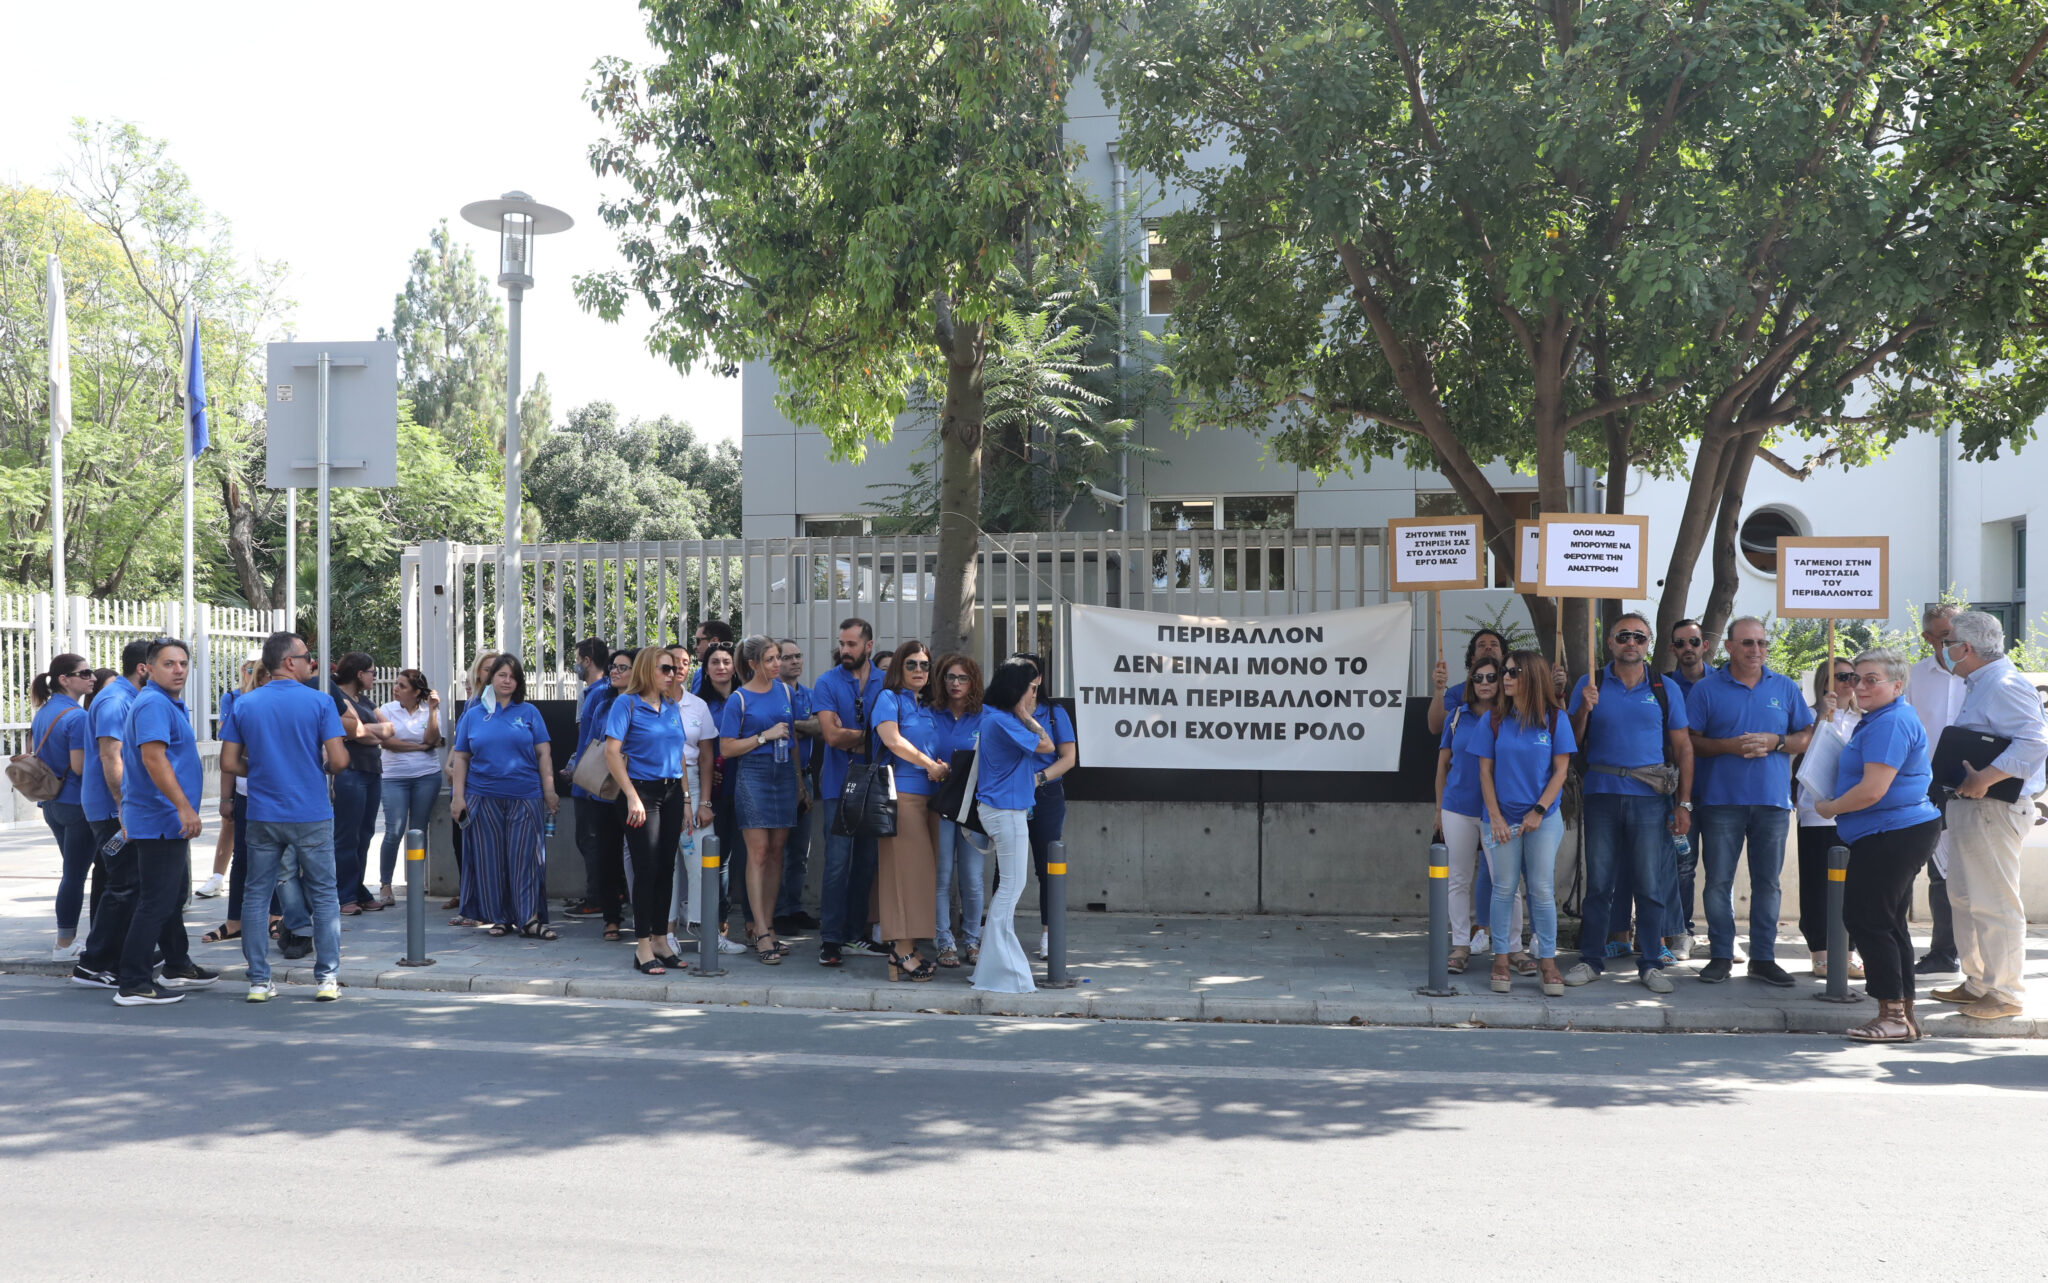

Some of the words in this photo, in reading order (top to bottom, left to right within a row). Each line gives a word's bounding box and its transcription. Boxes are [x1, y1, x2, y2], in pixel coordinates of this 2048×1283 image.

[1404, 530, 1447, 538] ΖΗΤΟΥΜΕ
[1447, 529, 1467, 537] ΤΗΝ
[1572, 529, 1594, 537] ΟΛΟΙ
[1594, 529, 1615, 537] ΜΑΖΙ
[1414, 539, 1452, 547] ΣΤΗΡΙΞΗ
[1453, 538, 1471, 546] ΣΑΣ
[1570, 541, 1618, 549] ΜΠΟΡΟΥΜΕ
[1619, 542, 1632, 550] ΝΑ
[1405, 549, 1424, 557] ΣΤΟ
[1424, 548, 1467, 556] ΔΥΣΚΟΛΟ
[1563, 552, 1605, 560] ΦΕΡΟΥΜΕ
[1605, 553, 1623, 561] ΤΗΝ
[1415, 558, 1438, 566] ΕΡΓΟ
[1439, 557, 1458, 565] ΜΑΣ
[1793, 559, 1843, 567] ΤΑΓΜΕΝΟΙ
[1845, 559, 1872, 567] ΣΤΗΝ
[1567, 564, 1619, 572] ΑΝΑΣΤΡΟΦΗ
[1805, 569, 1860, 577] ΠΡΟΣΤΑΣΙΑ
[1822, 579, 1842, 587] ΤΟΥ
[1792, 589, 1873, 597] ΠΕΡΙΒΑΛΛΟΝΤΟΣ
[1158, 626, 1323, 643] ΠΕΡΙΒΑΛΛΟΝ
[1114, 655, 1162, 673] ΔΕΝ
[1173, 657, 1238, 674] ΕΙΝΑΙ
[1248, 657, 1327, 675] ΜΟΝΟ
[1335, 657, 1367, 675] ΤΟ
[1080, 687, 1178, 706] ΤΜΗΜΑ
[1187, 689, 1402, 707] ΠΕΡΙΒΑΛΛΟΝΤΟΣ
[1115, 720, 1176, 738] ΟΛΟΙ
[1186, 722, 1286, 740] ΕΧΟΥΜΕ
[1295, 722, 1364, 740] ΡΟΛΟ
